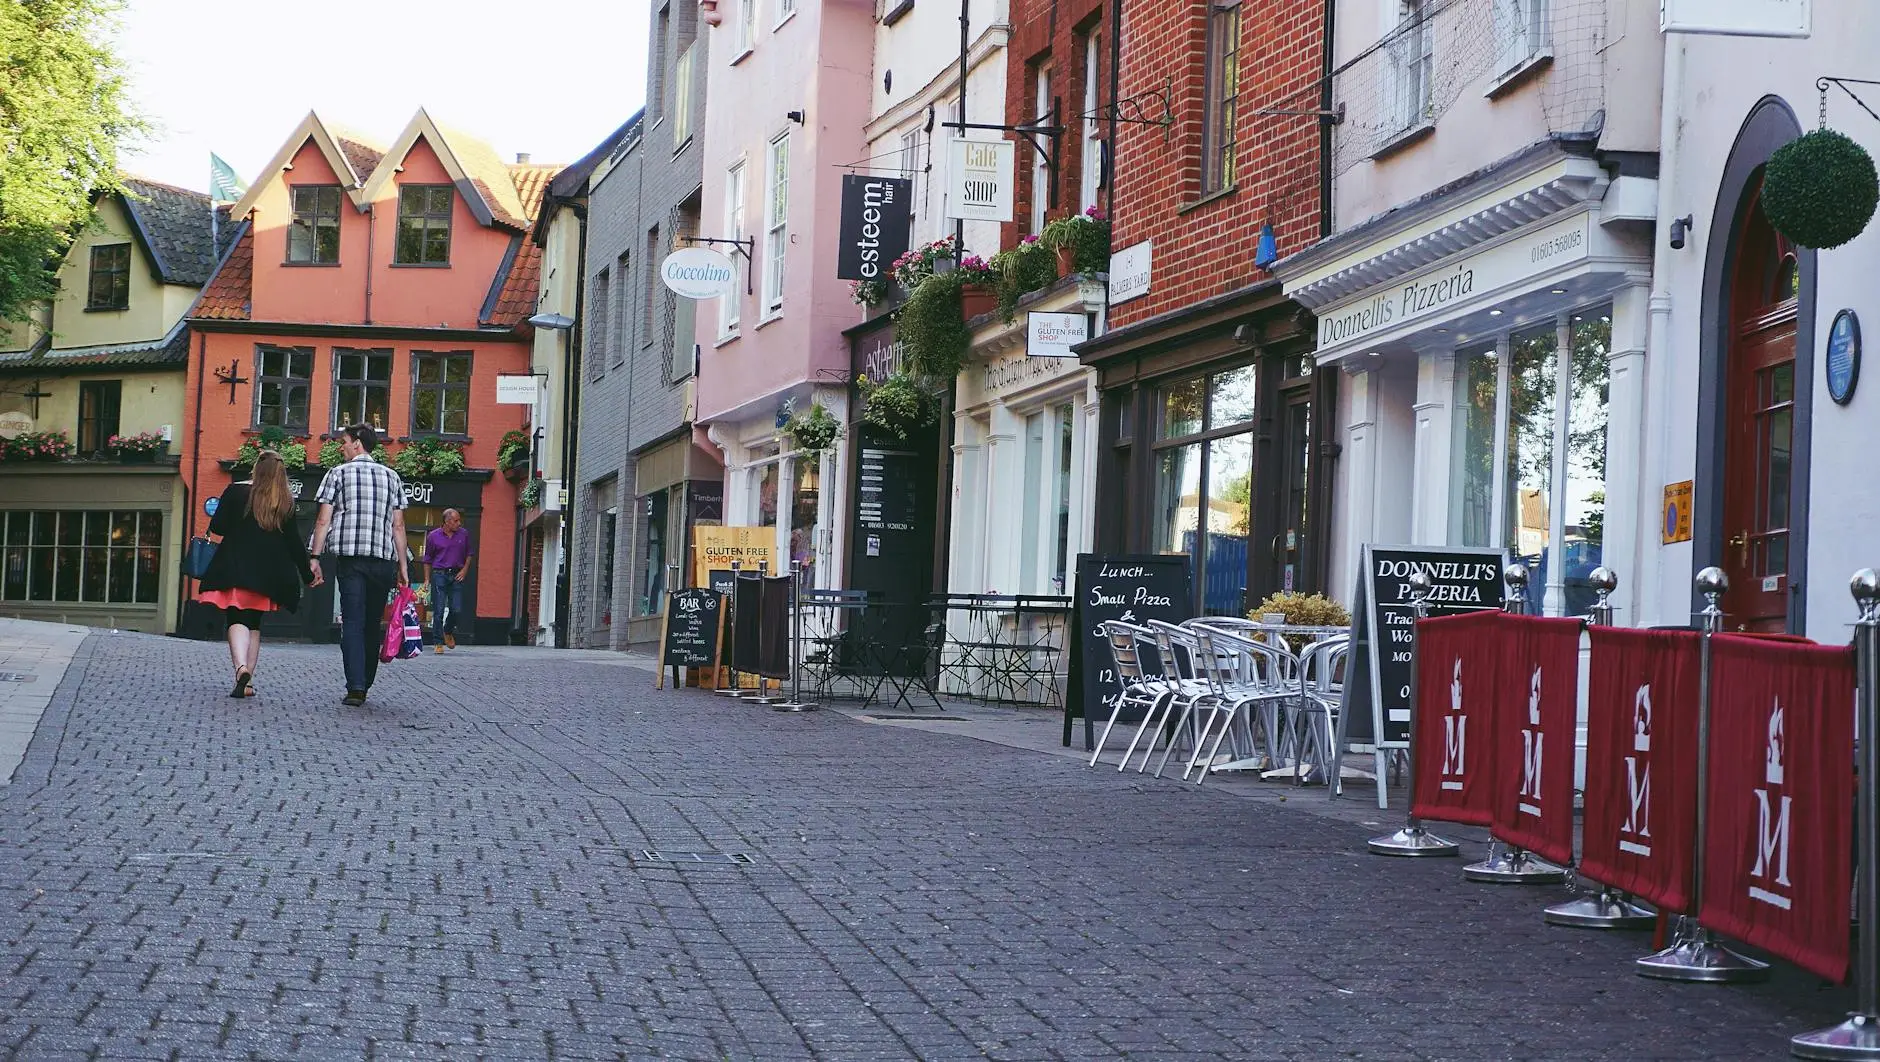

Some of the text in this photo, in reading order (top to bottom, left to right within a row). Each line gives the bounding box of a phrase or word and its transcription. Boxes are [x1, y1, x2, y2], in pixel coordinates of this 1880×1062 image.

[966, 143, 997, 167] Café
[882, 182, 894, 204] hair
[964, 181, 997, 202] SHOP
[857, 182, 882, 278] esteem
[1531, 241, 1553, 263] 01603
[668, 262, 731, 281] Coccolino
[1133, 272, 1148, 288] YARD
[1322, 264, 1474, 345] Donnellis Pizzeria
[1037, 328, 1066, 336] GLUTEN
[865, 340, 902, 382] esteem
[705, 546, 768, 556] GLUTEN FREE
[707, 555, 734, 564] SHOP
[1377, 560, 1497, 581] DONNELLI'S
[1133, 587, 1171, 607] Pizza
[1397, 583, 1482, 602] PIZERIA
[679, 597, 703, 613] BAR
[1120, 610, 1137, 621] &
[1099, 669, 1114, 683] 12
[1750, 788, 1793, 888] M
